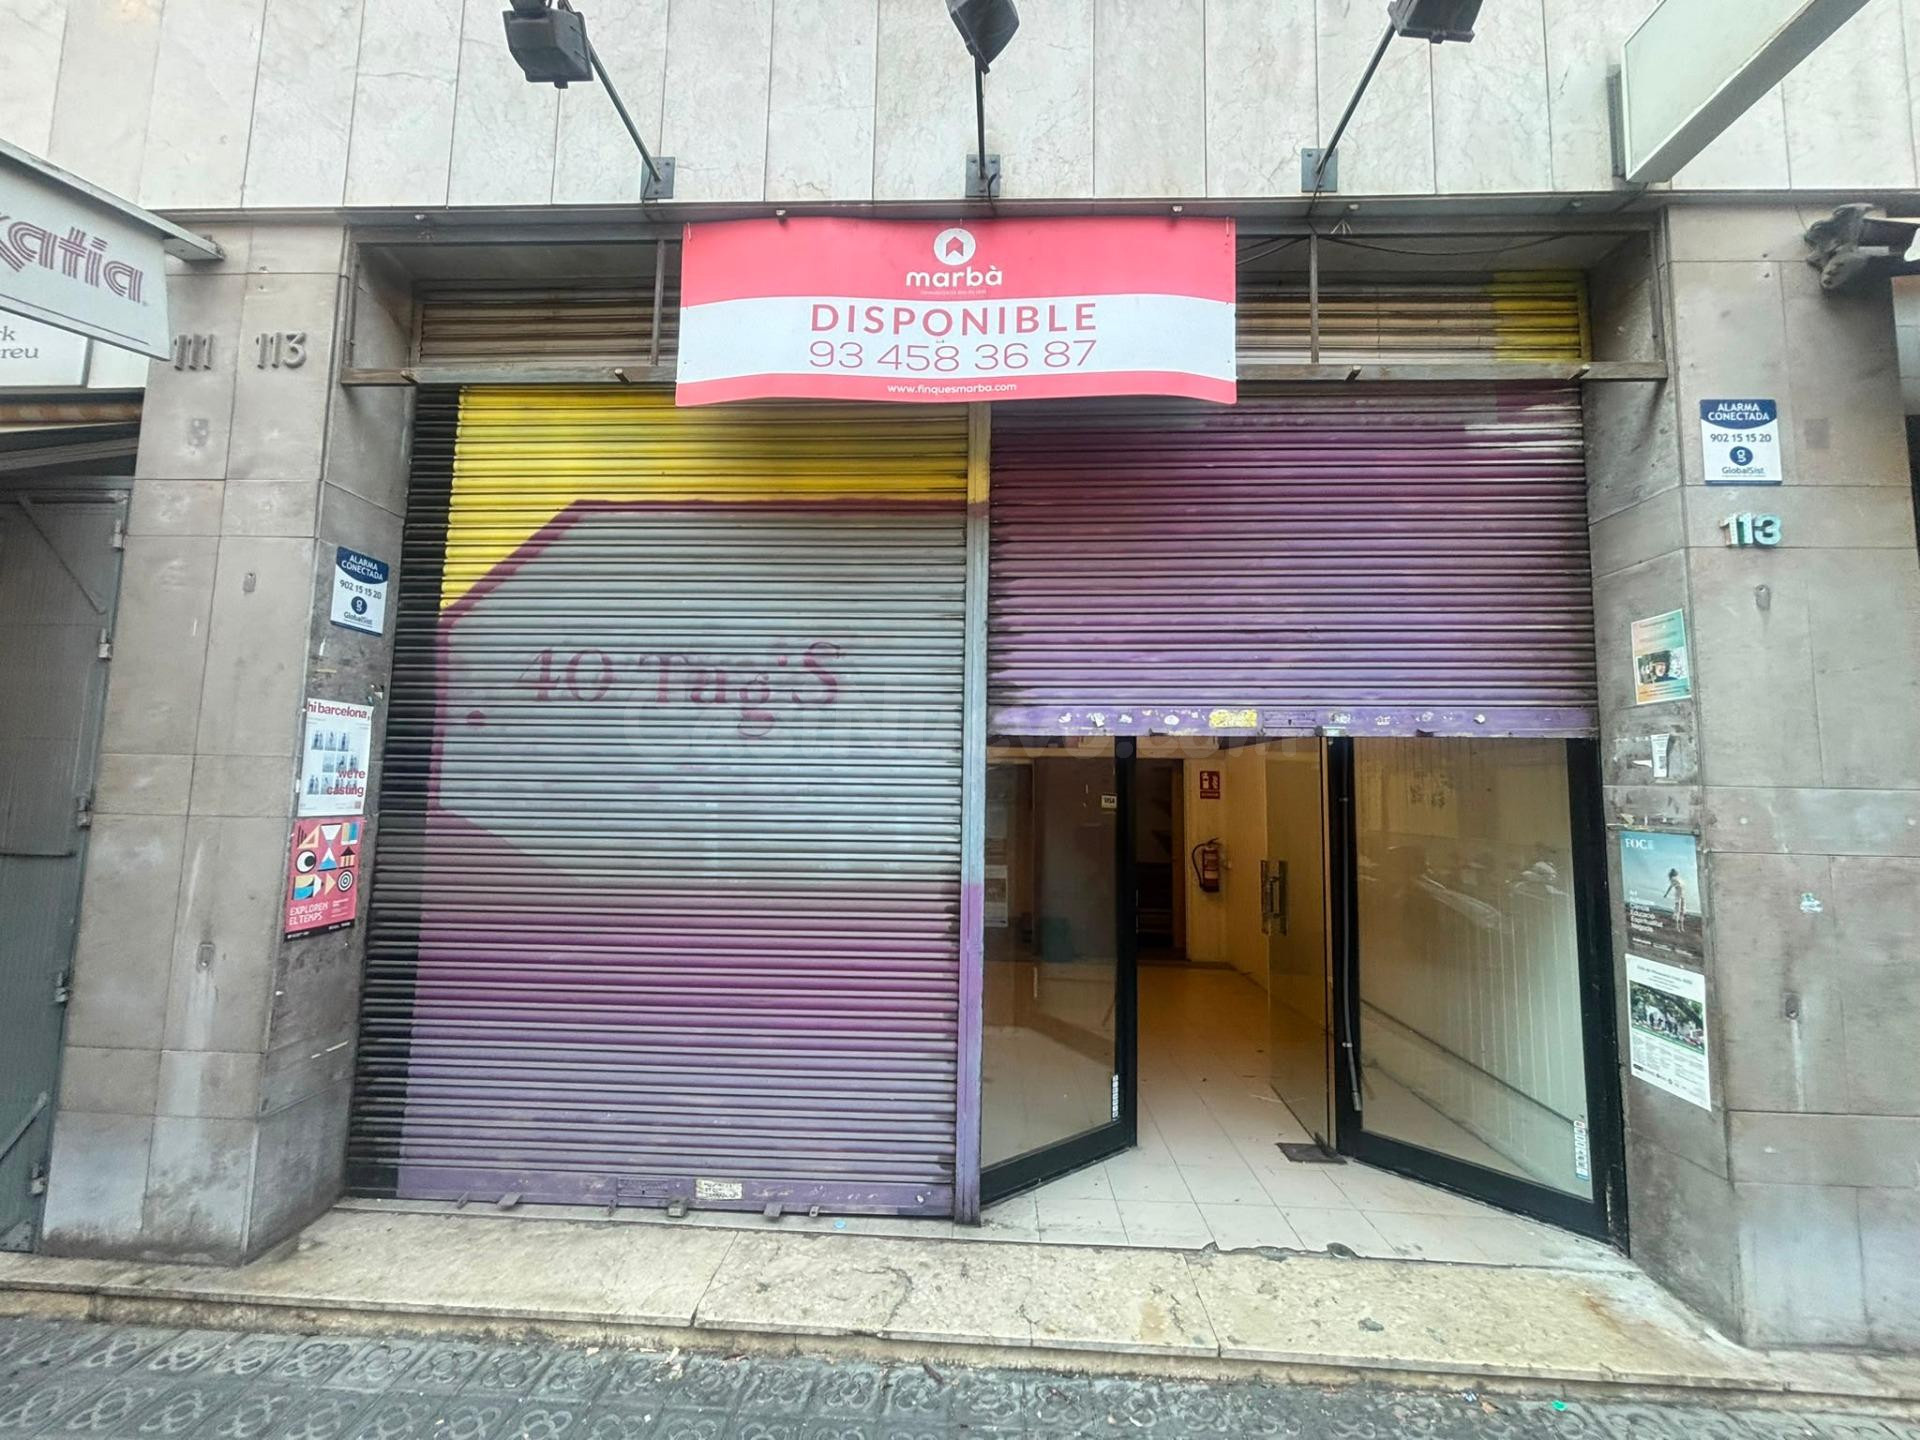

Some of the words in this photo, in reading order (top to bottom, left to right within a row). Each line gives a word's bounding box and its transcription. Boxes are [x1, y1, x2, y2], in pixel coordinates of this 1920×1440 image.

[905, 265, 1003, 288] marbà
[811, 303, 1097, 336] DISPONIBLE
[174, 334, 215, 371] 111
[256, 332, 306, 369] 113
[809, 340, 864, 369] 93
[876, 343, 960, 372] 458
[974, 343, 1029, 370] 36
[1043, 339, 1097, 368] 87
[887, 382, 1017, 396] www.finquesmarba.com
[1707, 411, 1770, 421] CONECTADA
[1717, 402, 1760, 412] ALARMA
[1710, 433, 1729, 443] 902
[1732, 433, 1743, 443] 15
[1745, 433, 1757, 443] 15
[1758, 433, 1772, 443] 20
[1720, 512, 1782, 546] 113
[341, 560, 384, 581] CONECTADA
[350, 554, 378, 571] ALARMA
[340, 579, 354, 591] 902
[355, 584, 363, 594] 15
[372, 590, 382, 600] 20
[307, 701, 317, 713] hi
[326, 785, 364, 797] casting
